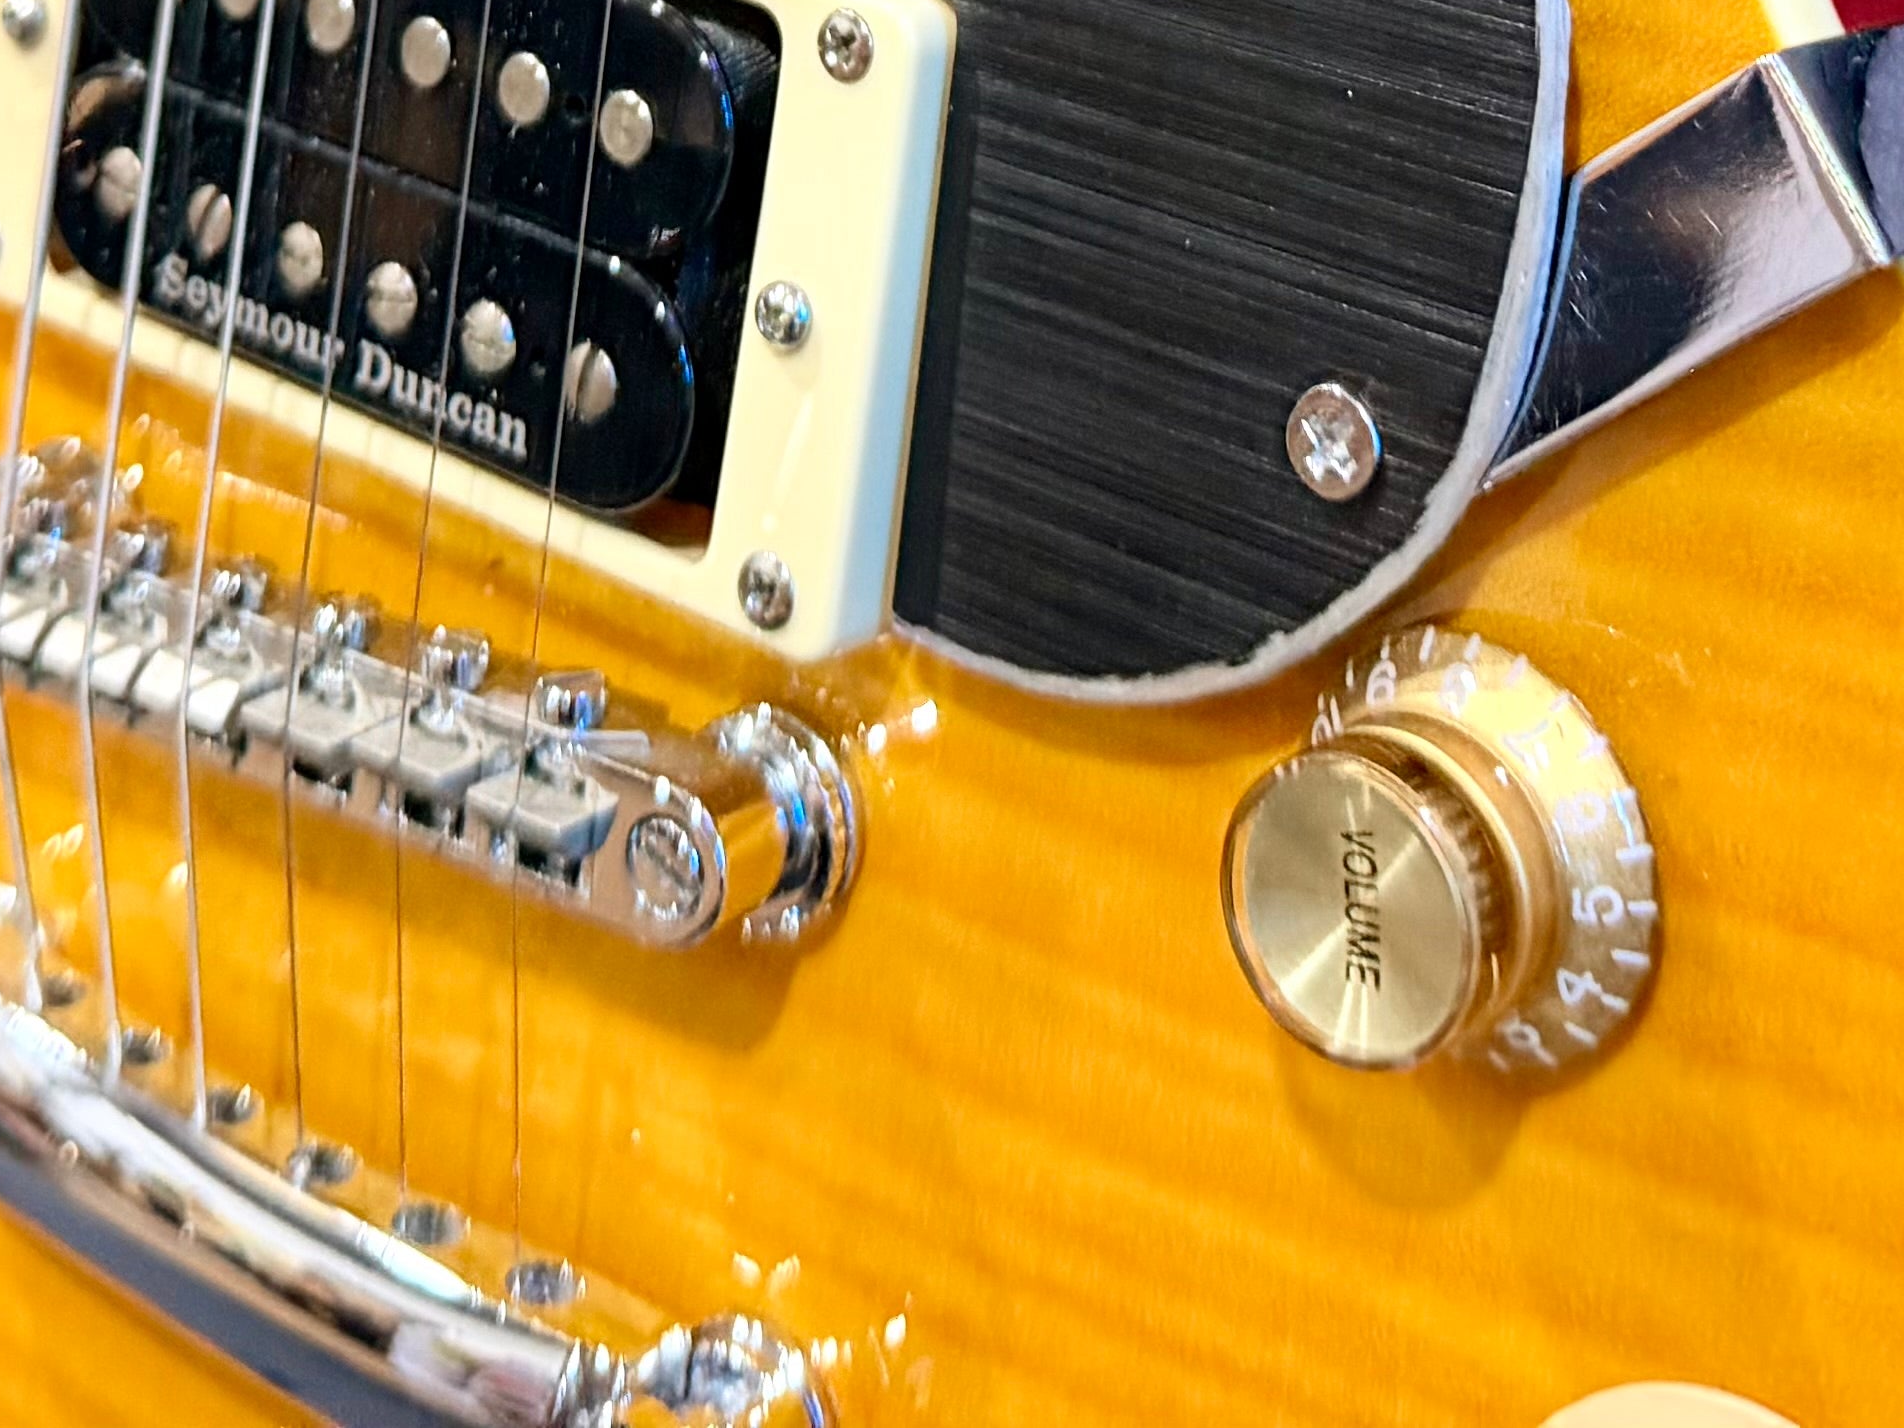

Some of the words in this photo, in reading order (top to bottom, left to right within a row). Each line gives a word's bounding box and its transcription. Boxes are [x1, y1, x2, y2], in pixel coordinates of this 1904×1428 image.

[153, 249, 345, 367] Seymour
[355, 339, 529, 463] Duncan
[1339, 829, 1382, 993] VOLUME
[1571, 884, 1626, 926] 5
